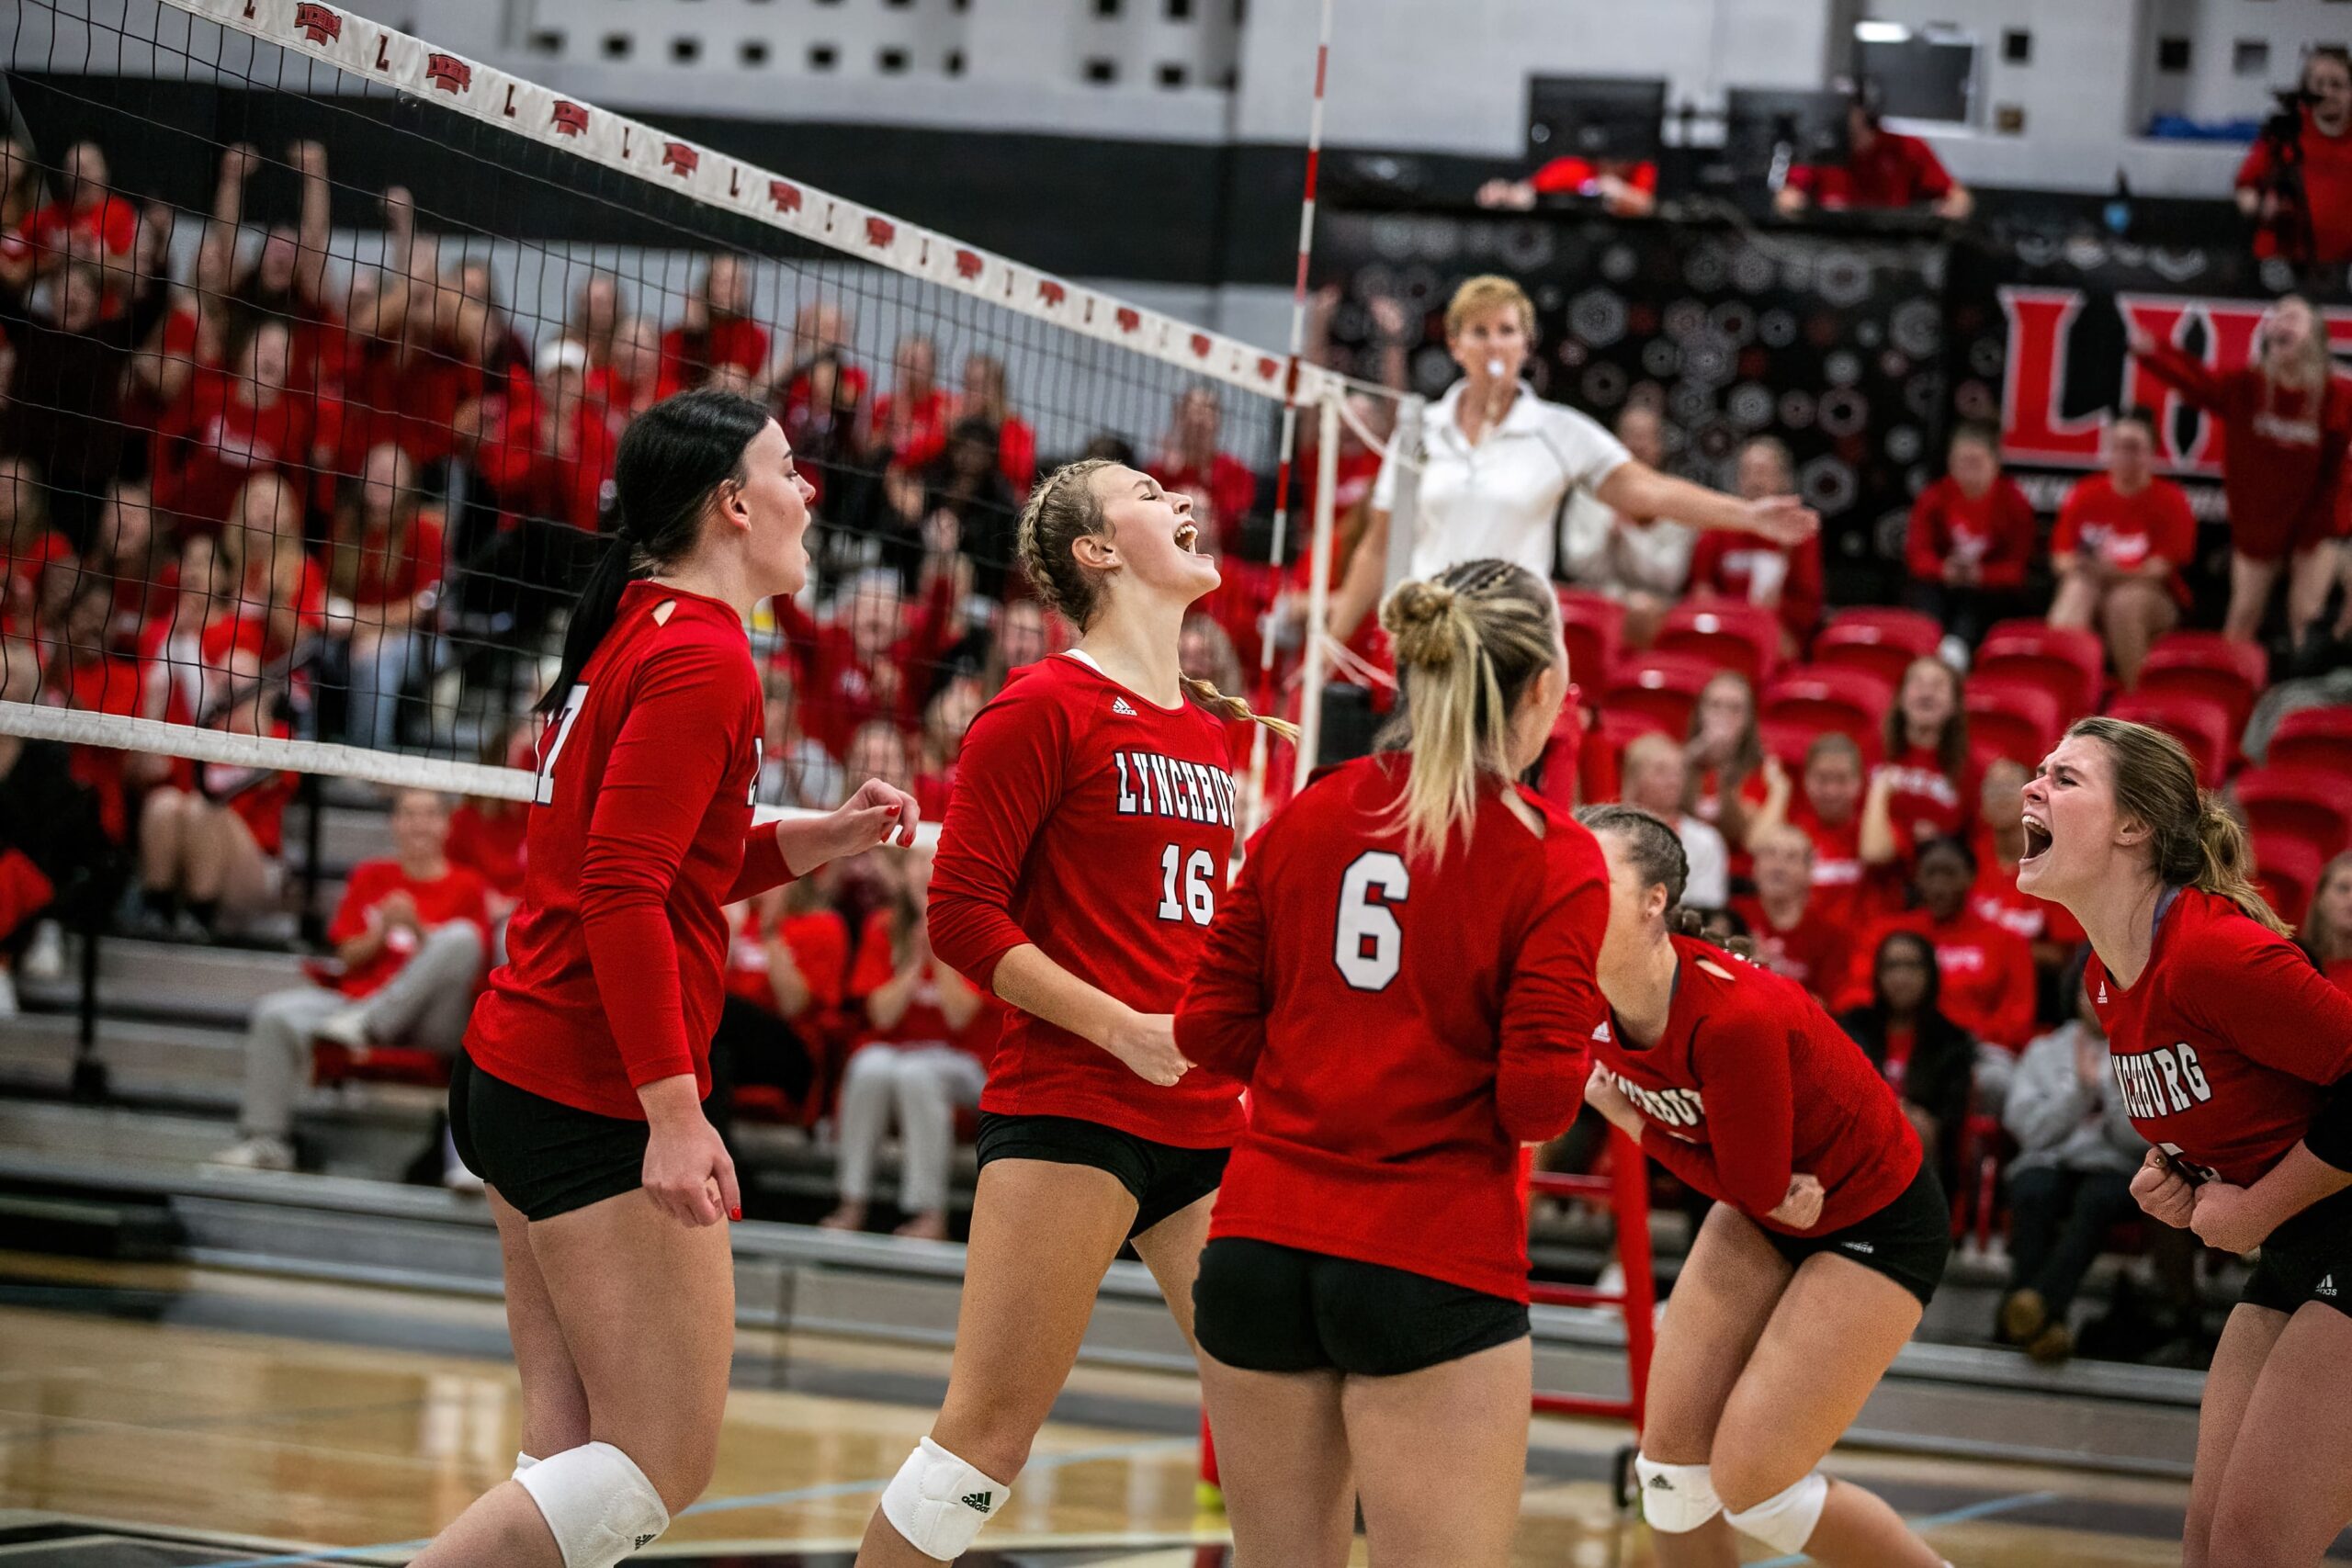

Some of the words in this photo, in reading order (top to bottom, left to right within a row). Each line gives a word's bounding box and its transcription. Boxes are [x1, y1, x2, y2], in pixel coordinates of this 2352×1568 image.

[375, 34, 390, 72] L
[503, 84, 516, 118] L
[535, 683, 590, 805] 7
[1114, 751, 1237, 830] LYNCHBUR
[1159, 843, 1215, 926] 16
[1335, 851, 1410, 991] 6
[961, 1495, 990, 1514] adidas
